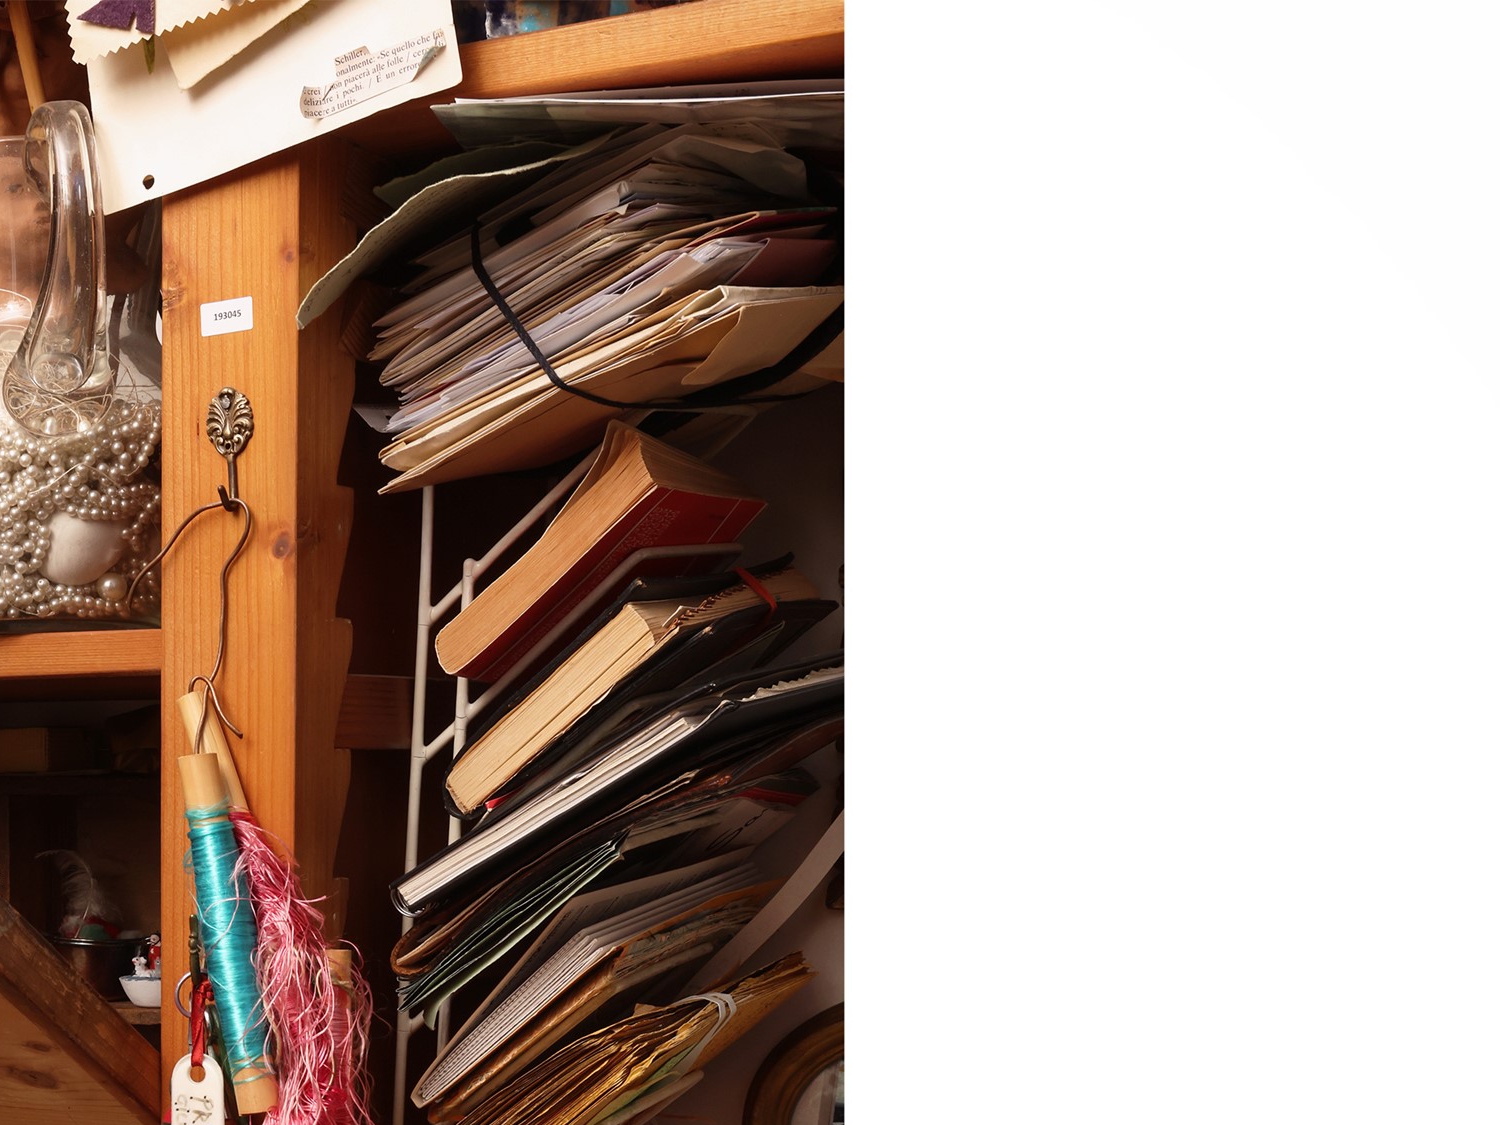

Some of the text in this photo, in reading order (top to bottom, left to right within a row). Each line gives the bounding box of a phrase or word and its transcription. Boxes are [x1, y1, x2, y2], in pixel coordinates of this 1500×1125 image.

[391, 39, 416, 56] quello
[416, 34, 431, 46] che
[334, 49, 367, 66] Schiller,
[344, 70, 371, 87] piacerà
[371, 63, 386, 75] alle
[386, 55, 404, 68] folle
[385, 70, 396, 80] un
[213, 308, 242, 321] 193045
